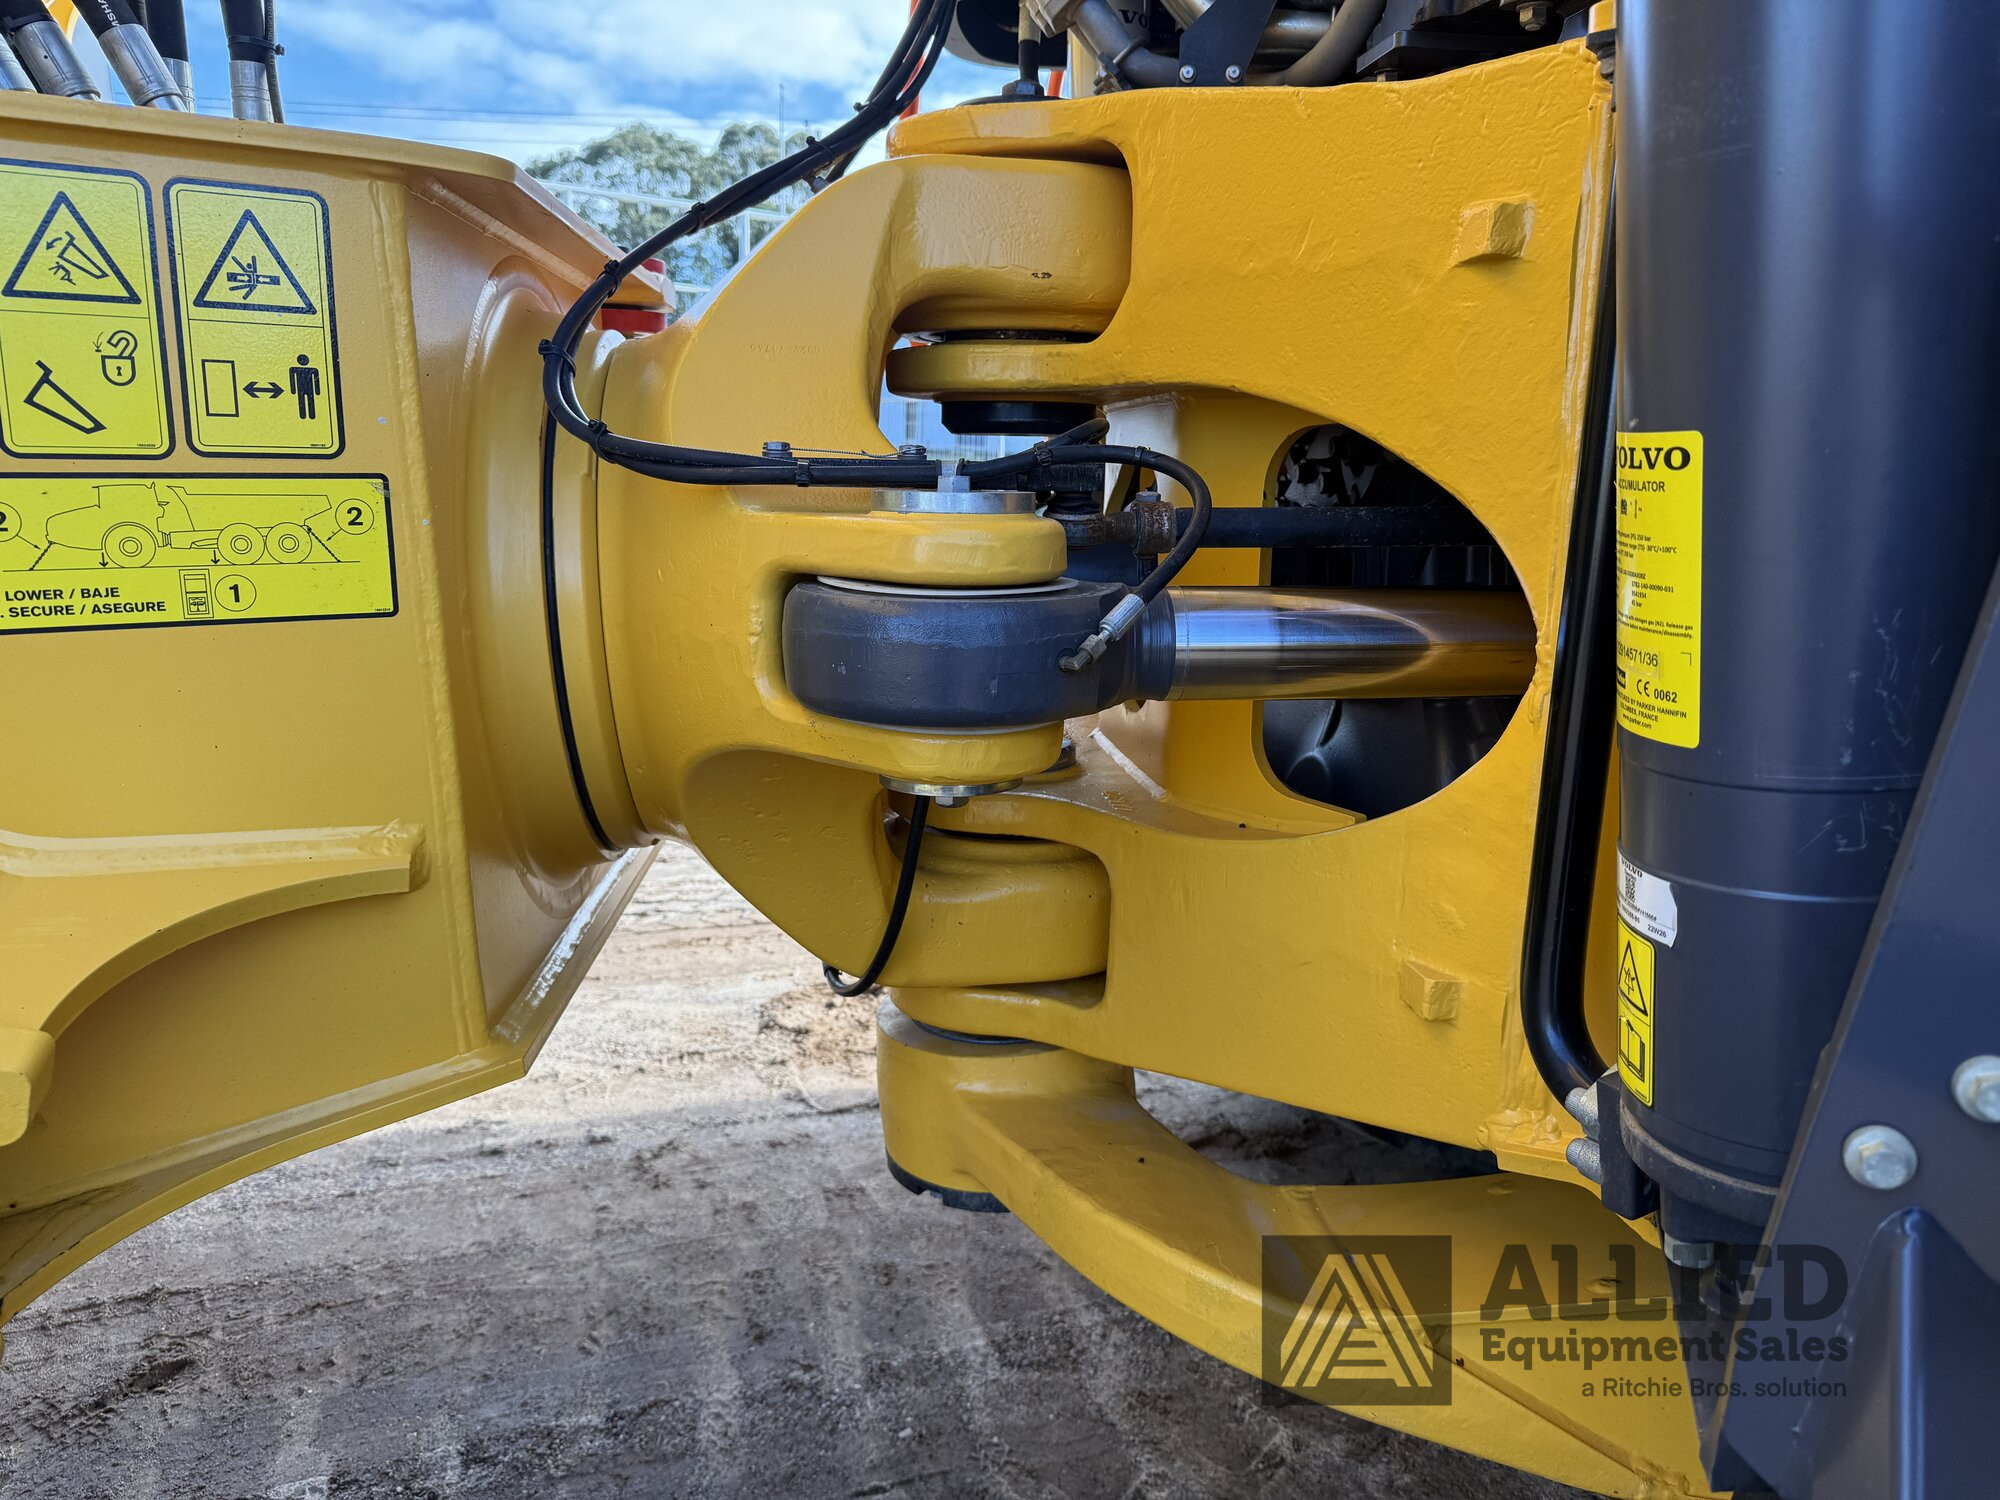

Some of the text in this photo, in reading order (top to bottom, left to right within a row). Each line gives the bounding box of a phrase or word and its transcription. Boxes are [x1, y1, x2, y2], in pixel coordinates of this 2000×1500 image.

[1617, 446, 1691, 471] OLVO
[347, 506, 364, 527] 2
[4, 586, 120, 602] LOWER / BAJE
[228, 583, 241, 603] 1
[8, 600, 166, 618] SECURE / ASEGURE
[1666, 622, 1684, 630] Release
[1653, 688, 1678, 703] 0062
[1636, 699, 1656, 712] PARKER
[1656, 706, 1687, 719] HANNIFIN
[1638, 710, 1659, 722] FRANCE
[1621, 857, 1643, 878] VOLVO
